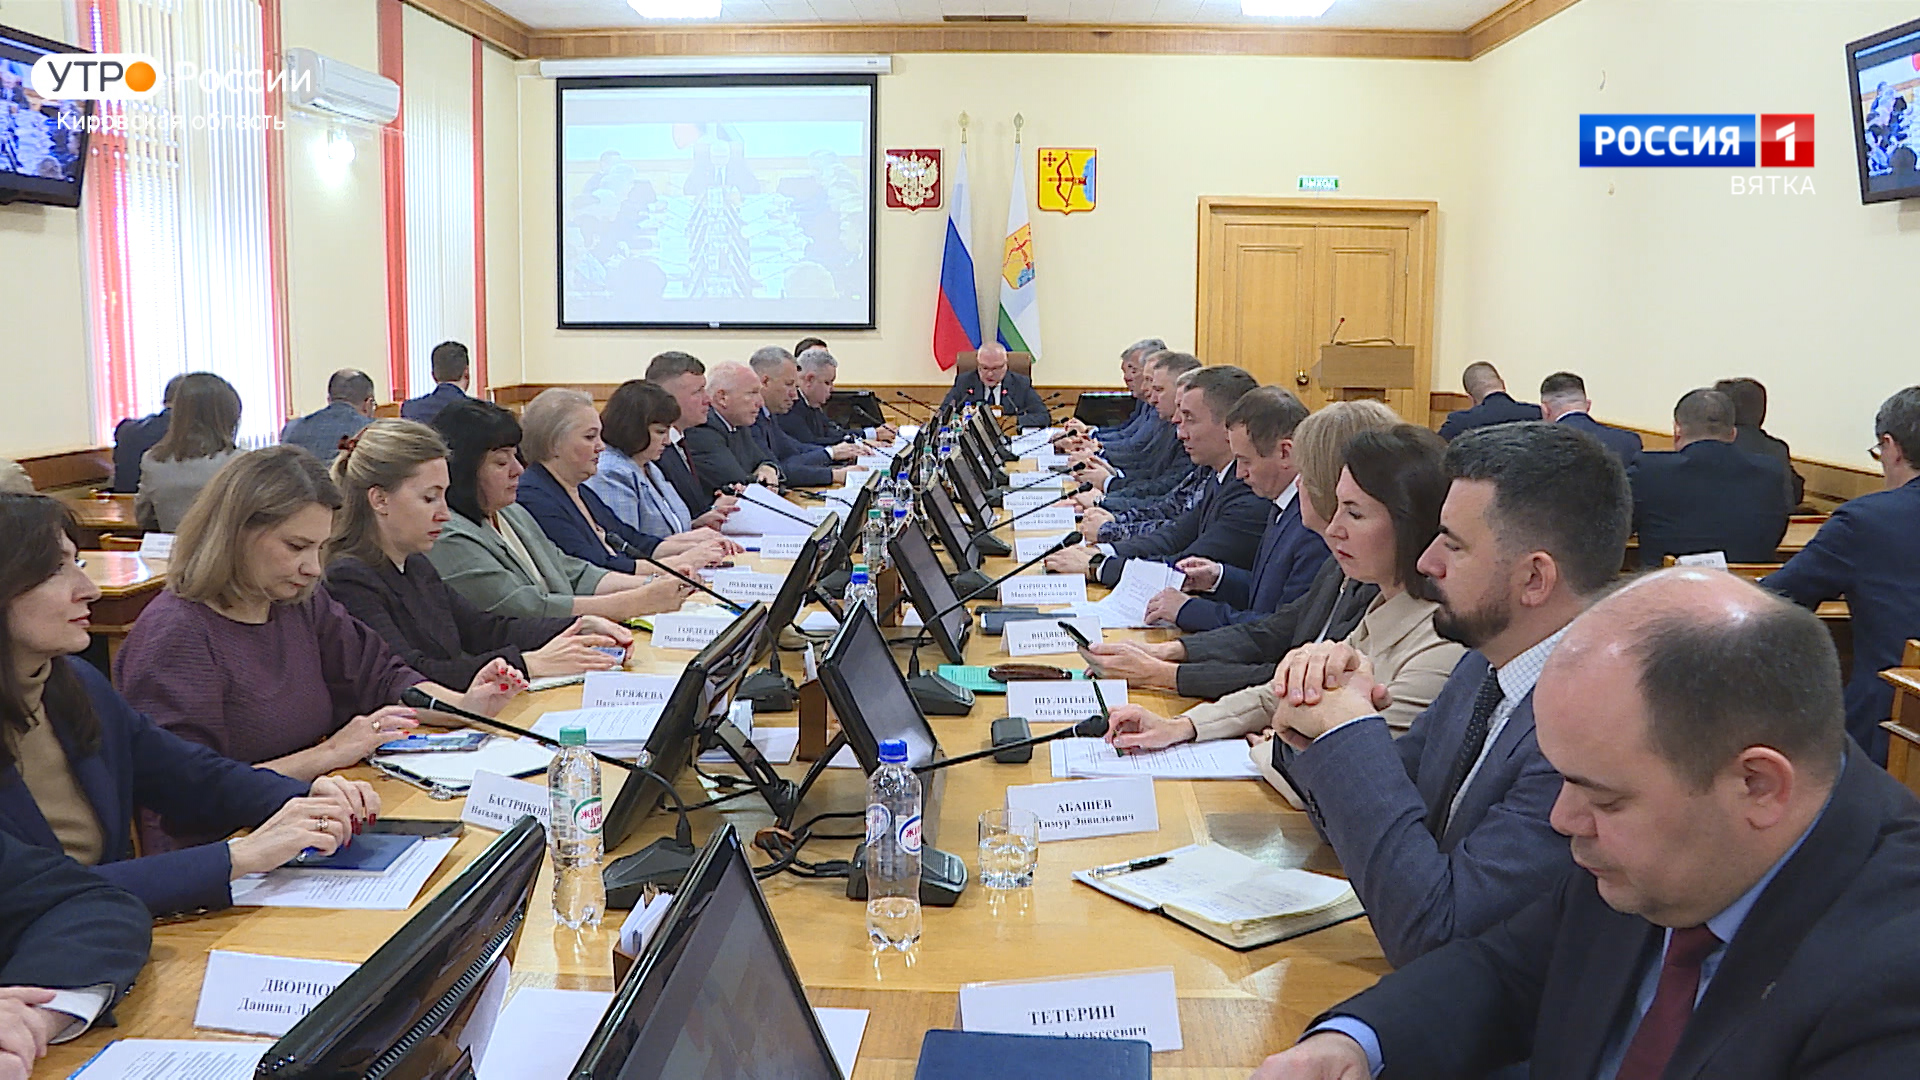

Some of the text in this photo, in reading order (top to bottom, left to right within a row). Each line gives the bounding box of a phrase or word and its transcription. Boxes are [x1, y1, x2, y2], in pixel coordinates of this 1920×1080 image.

[1031, 631, 1068, 640] ВИДЯКИ
[615, 689, 664, 700] КРЯЖЕВА
[1033, 695, 1099, 706] ШУЛЯТЬЕВ
[488, 794, 548, 816] БАСТРИКОВ
[1057, 799, 1112, 813] АБАШЕВ
[237, 998, 291, 1015] Даниил
[1028, 1005, 1116, 1026] ТЕТЕРИН
